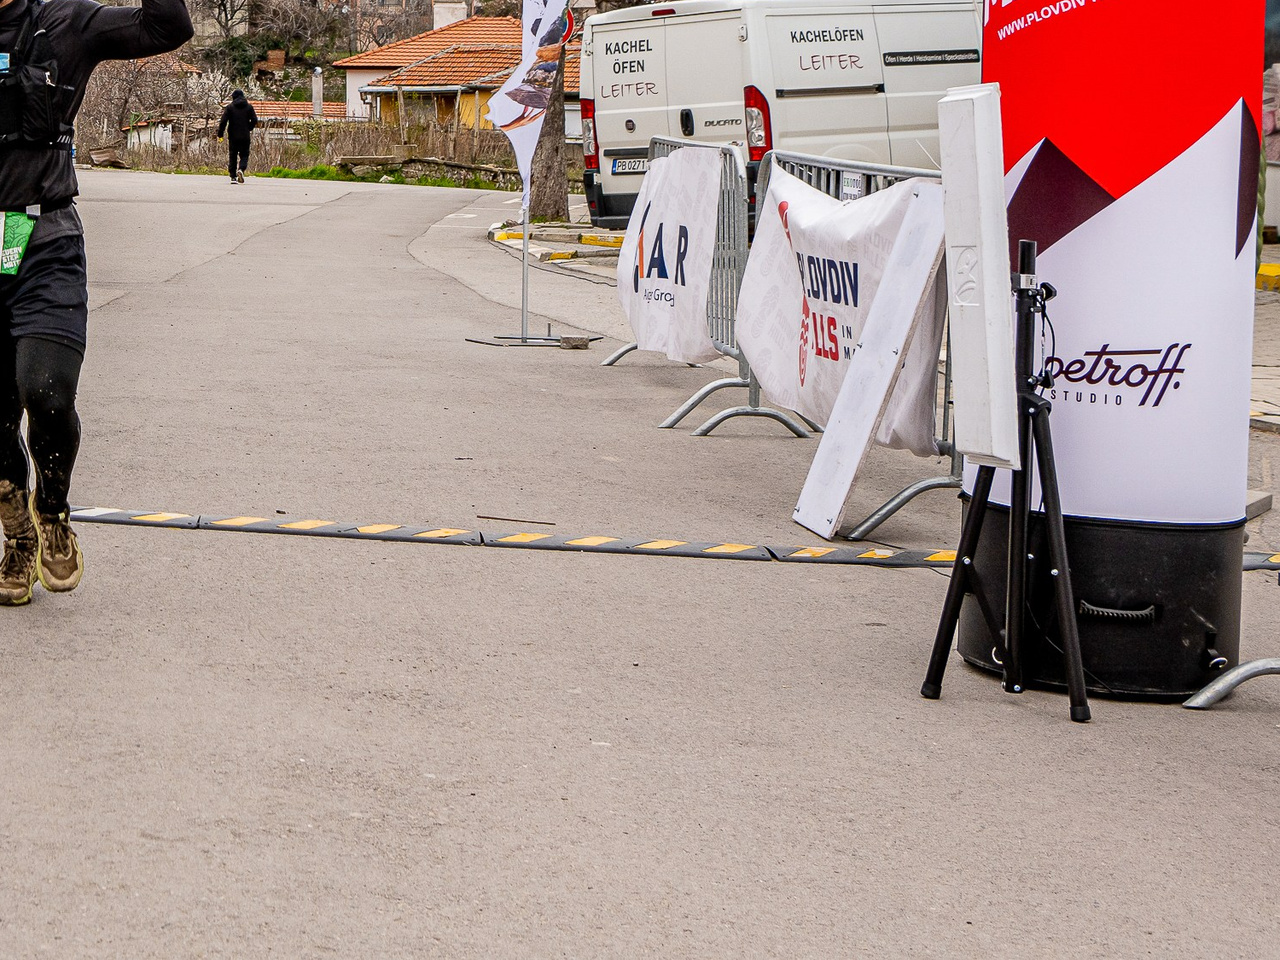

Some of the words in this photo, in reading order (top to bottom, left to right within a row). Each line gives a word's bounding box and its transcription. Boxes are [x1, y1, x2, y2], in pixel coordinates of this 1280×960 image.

[790, 26, 864, 44] KACHELÖFEN
[605, 39, 653, 56] KACHEL
[613, 58, 645, 74] ÖFEN
[799, 53, 864, 71] LEITER
[601, 82, 659, 99] LEITER
[704, 118, 742, 127] DUCATO
[841, 324, 853, 340] IN
[1050, 389, 1122, 406] STUDIO
